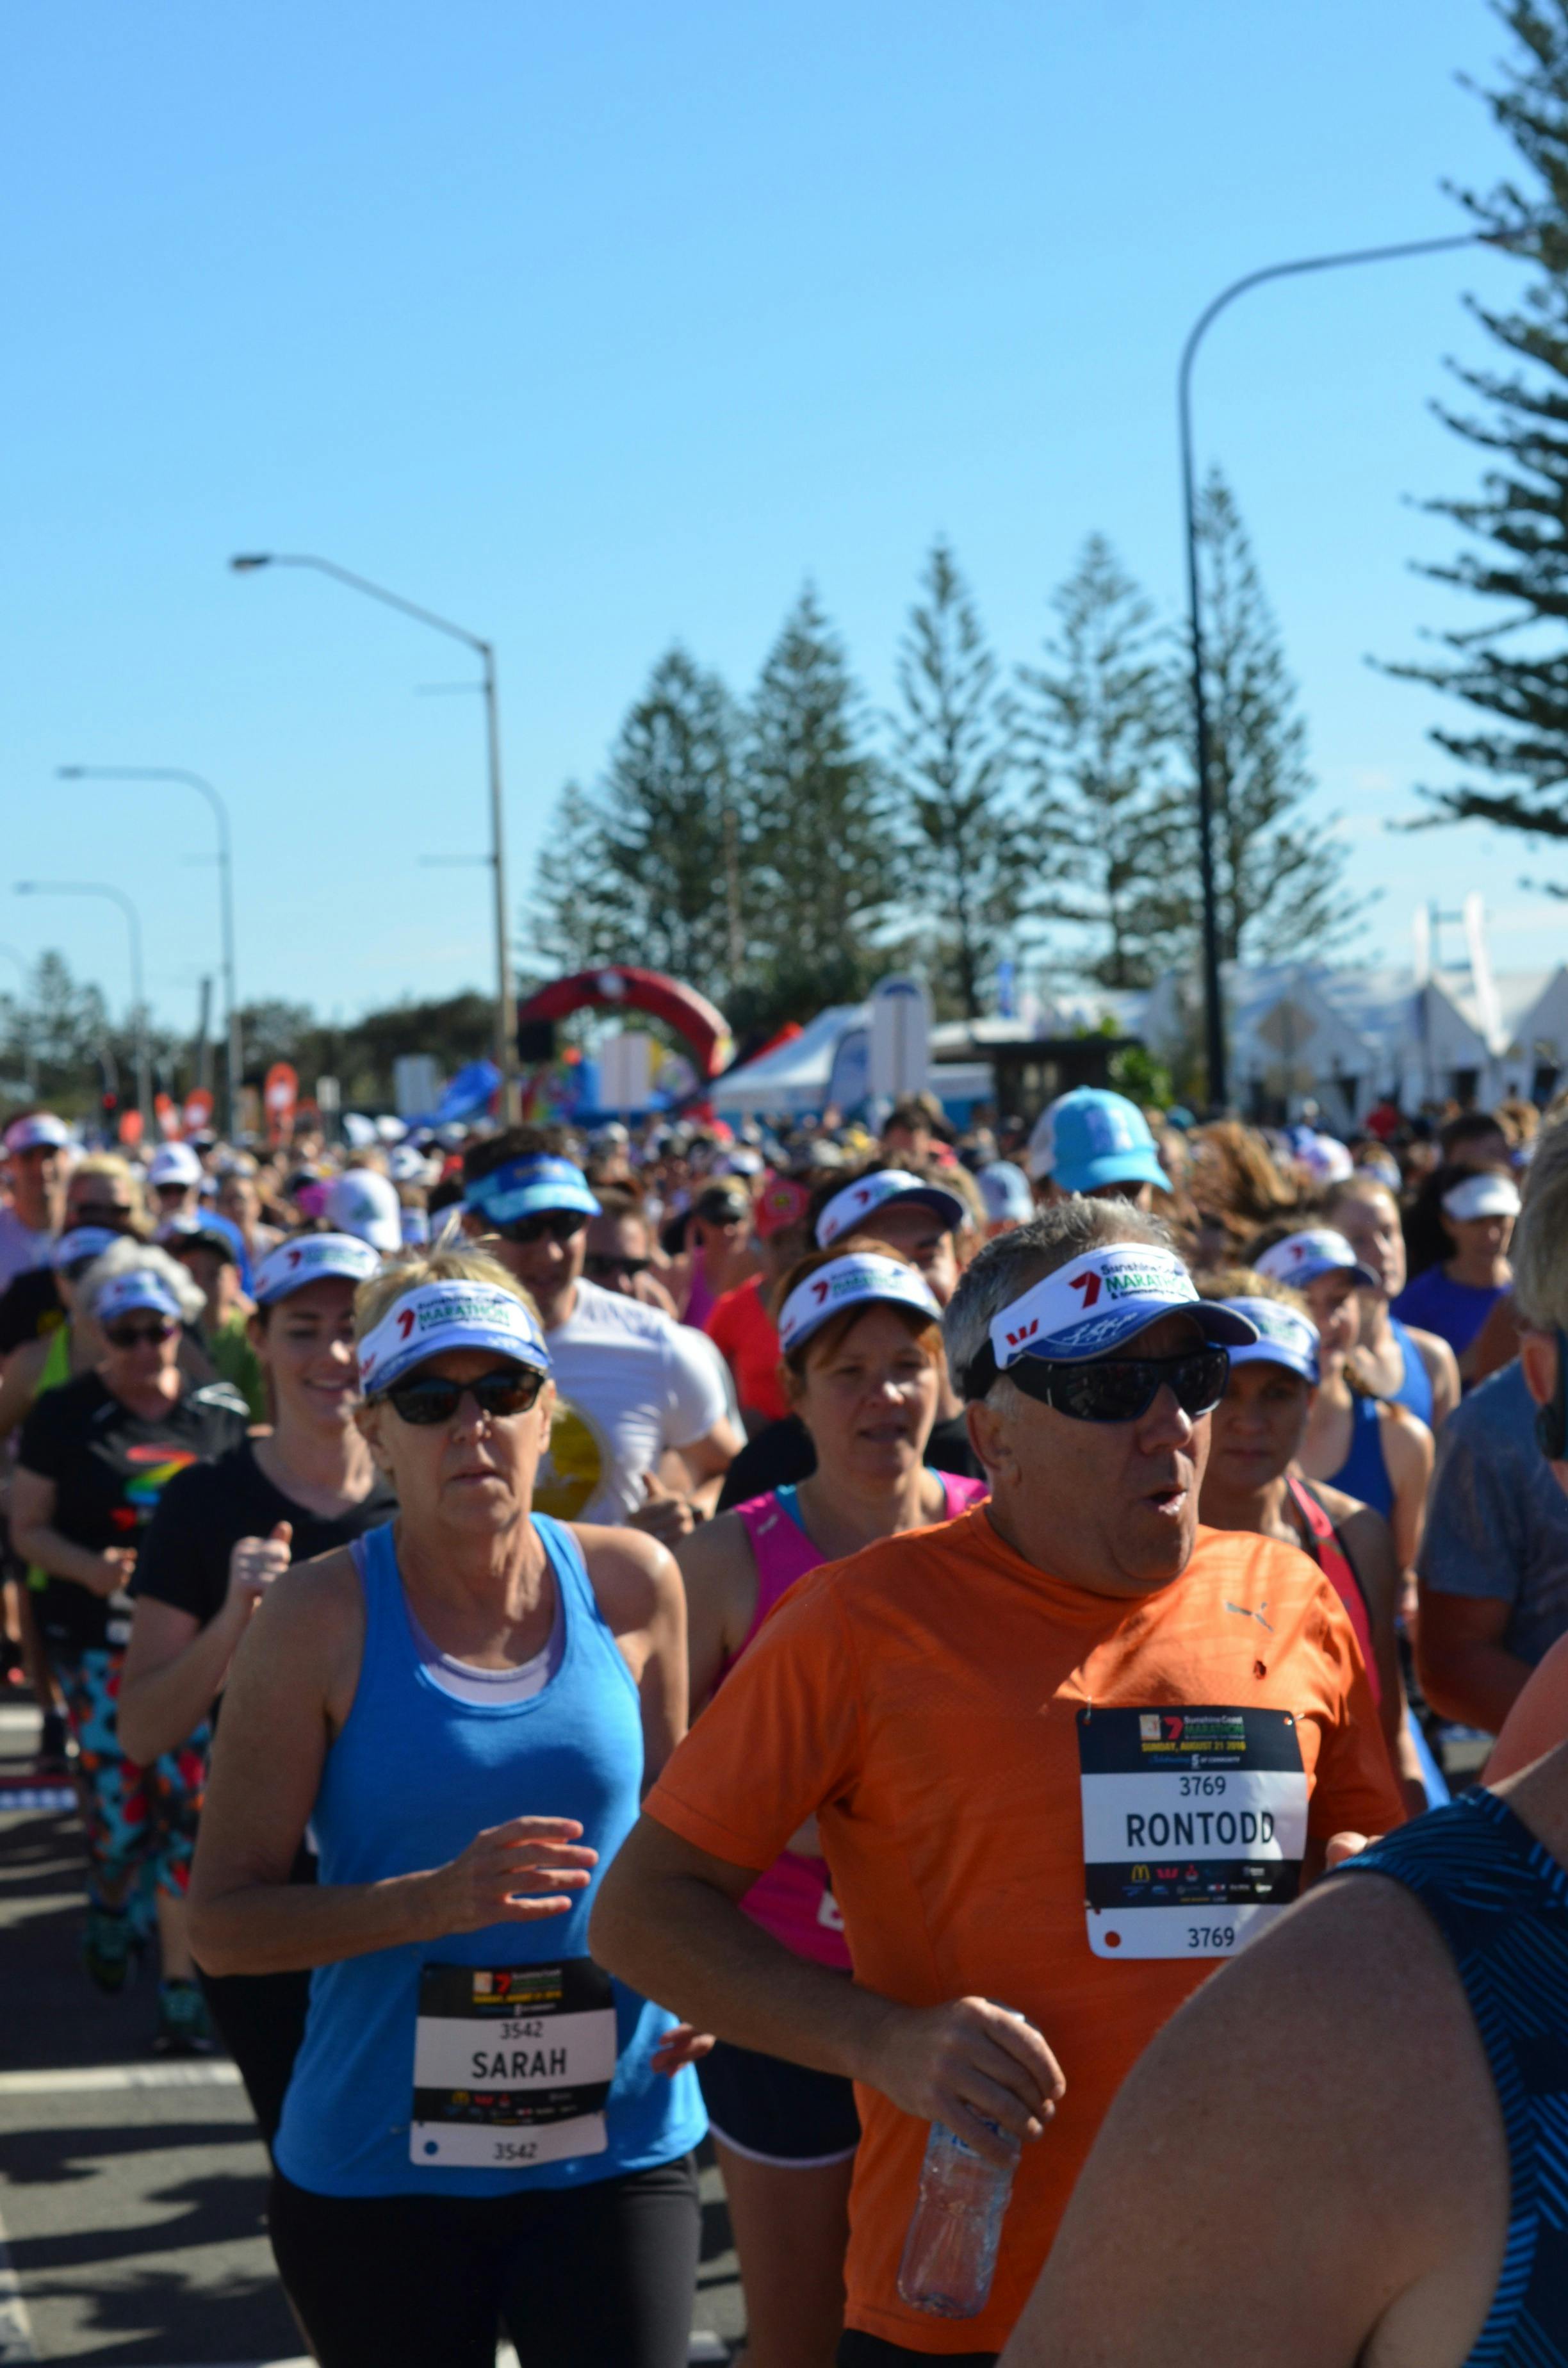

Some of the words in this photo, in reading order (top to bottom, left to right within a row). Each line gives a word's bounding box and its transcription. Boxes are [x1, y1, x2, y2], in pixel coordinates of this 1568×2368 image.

[1068, 1271, 1102, 1309] 7
[1163, 1716, 1184, 1739] 7
[1180, 1776, 1226, 1796] 3769
[1126, 1812, 1275, 1846] RONTODD
[1188, 1927, 1235, 1948] 3769
[500, 2021, 543, 2039] 3542
[471, 2048, 566, 2079] SARAH
[493, 2142, 537, 2160] 3542
